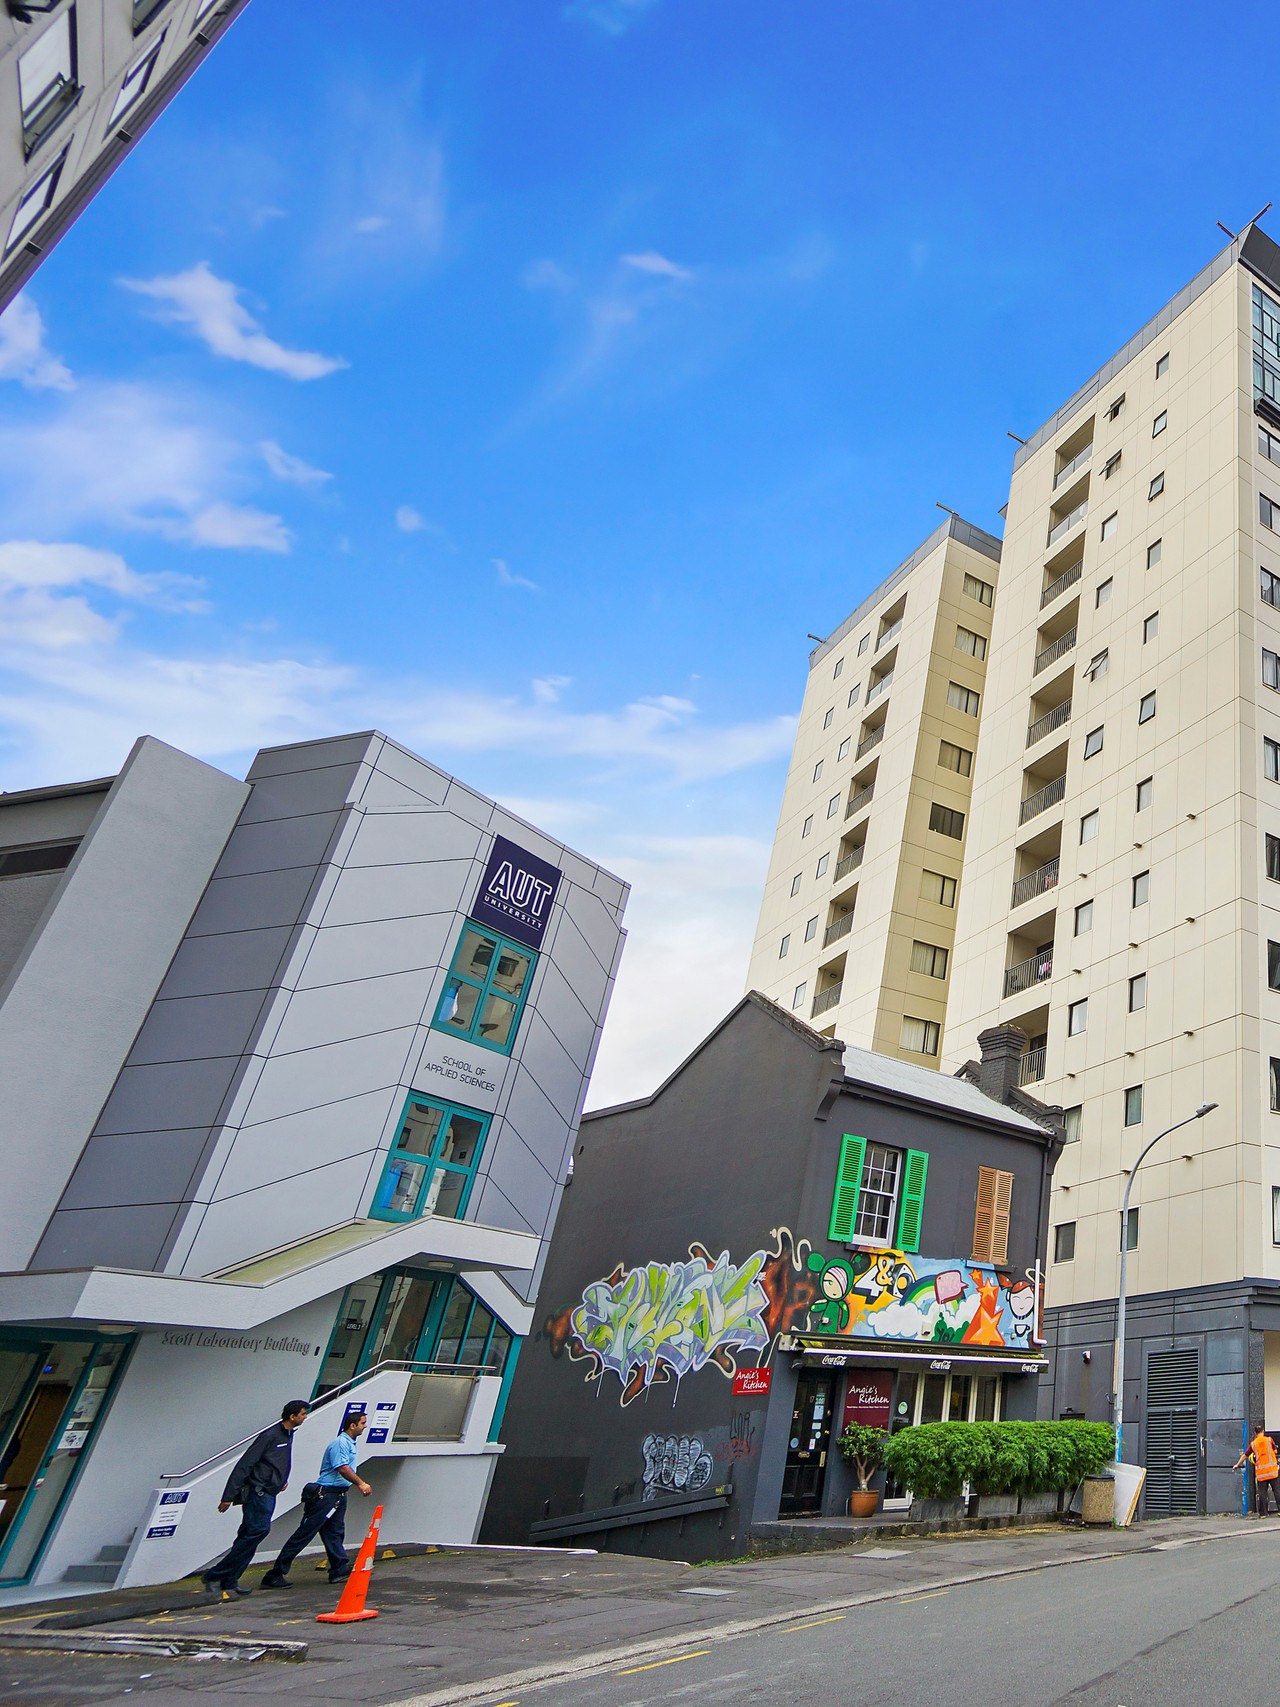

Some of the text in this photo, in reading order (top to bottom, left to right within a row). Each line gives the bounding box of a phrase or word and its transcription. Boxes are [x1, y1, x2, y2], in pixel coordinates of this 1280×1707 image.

[488, 860, 553, 917] AUT
[484, 895, 543, 928] UNIVERSITY
[424, 1062, 496, 1092] APPLIED SCIENCES
[442, 1055, 486, 1076] SCHOOL OF
[162, 1330, 312, 1357] Scott Laboratory Building
[736, 1370, 760, 1381] Angie's
[848, 1385, 878, 1395] Angie's
